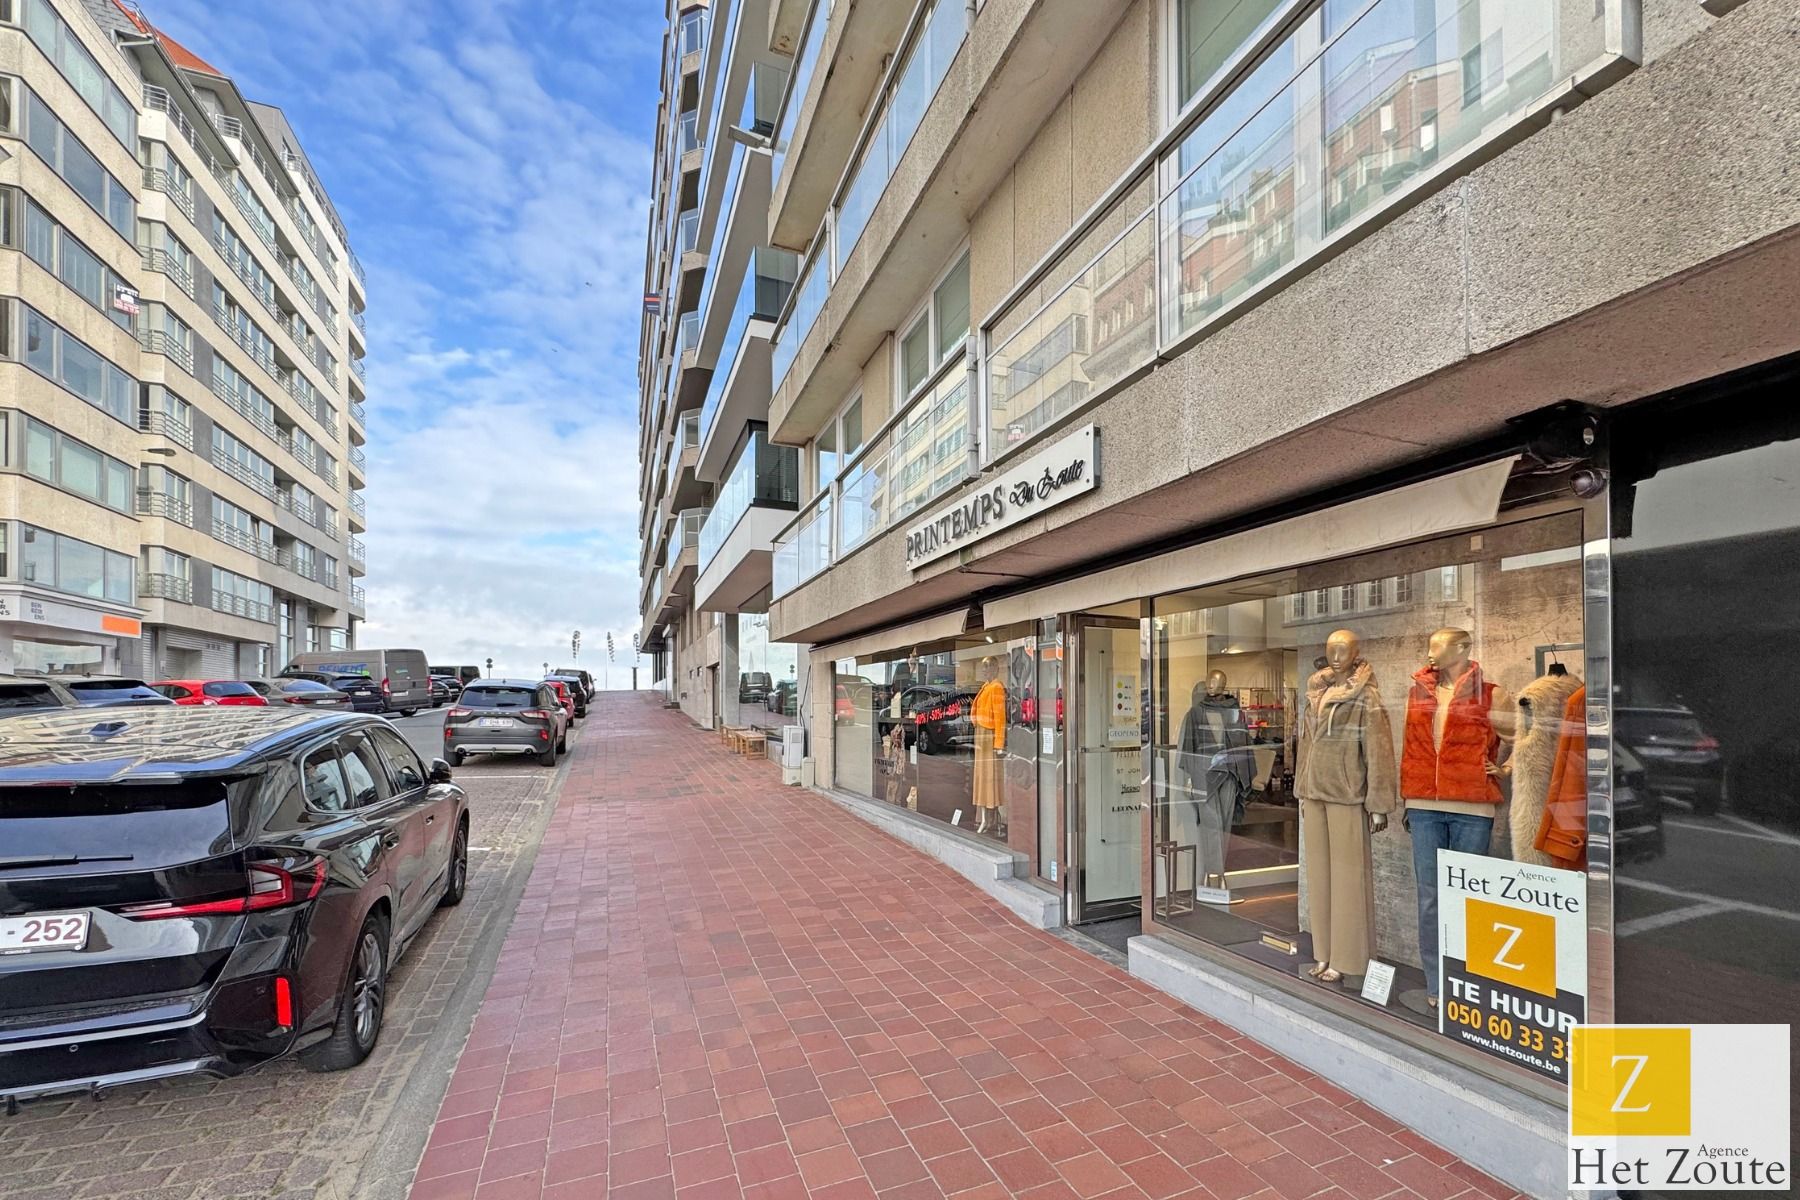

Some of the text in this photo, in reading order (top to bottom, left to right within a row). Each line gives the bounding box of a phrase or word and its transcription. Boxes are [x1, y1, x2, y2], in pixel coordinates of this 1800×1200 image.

[906, 485, 1004, 561] PRINTEMPS
[1446, 865, 1580, 913] Het Zoute
[1516, 868, 1557, 883] Agence
[1493, 922, 1526, 971] Z
[1447, 976, 1579, 1036] TE HUUR
[1447, 1001, 1482, 1030] 050
[1487, 1015, 1512, 1040] 60
[1518, 1024, 1544, 1051] 33
[1462, 1030, 1561, 1074] www.hetzoute.be
